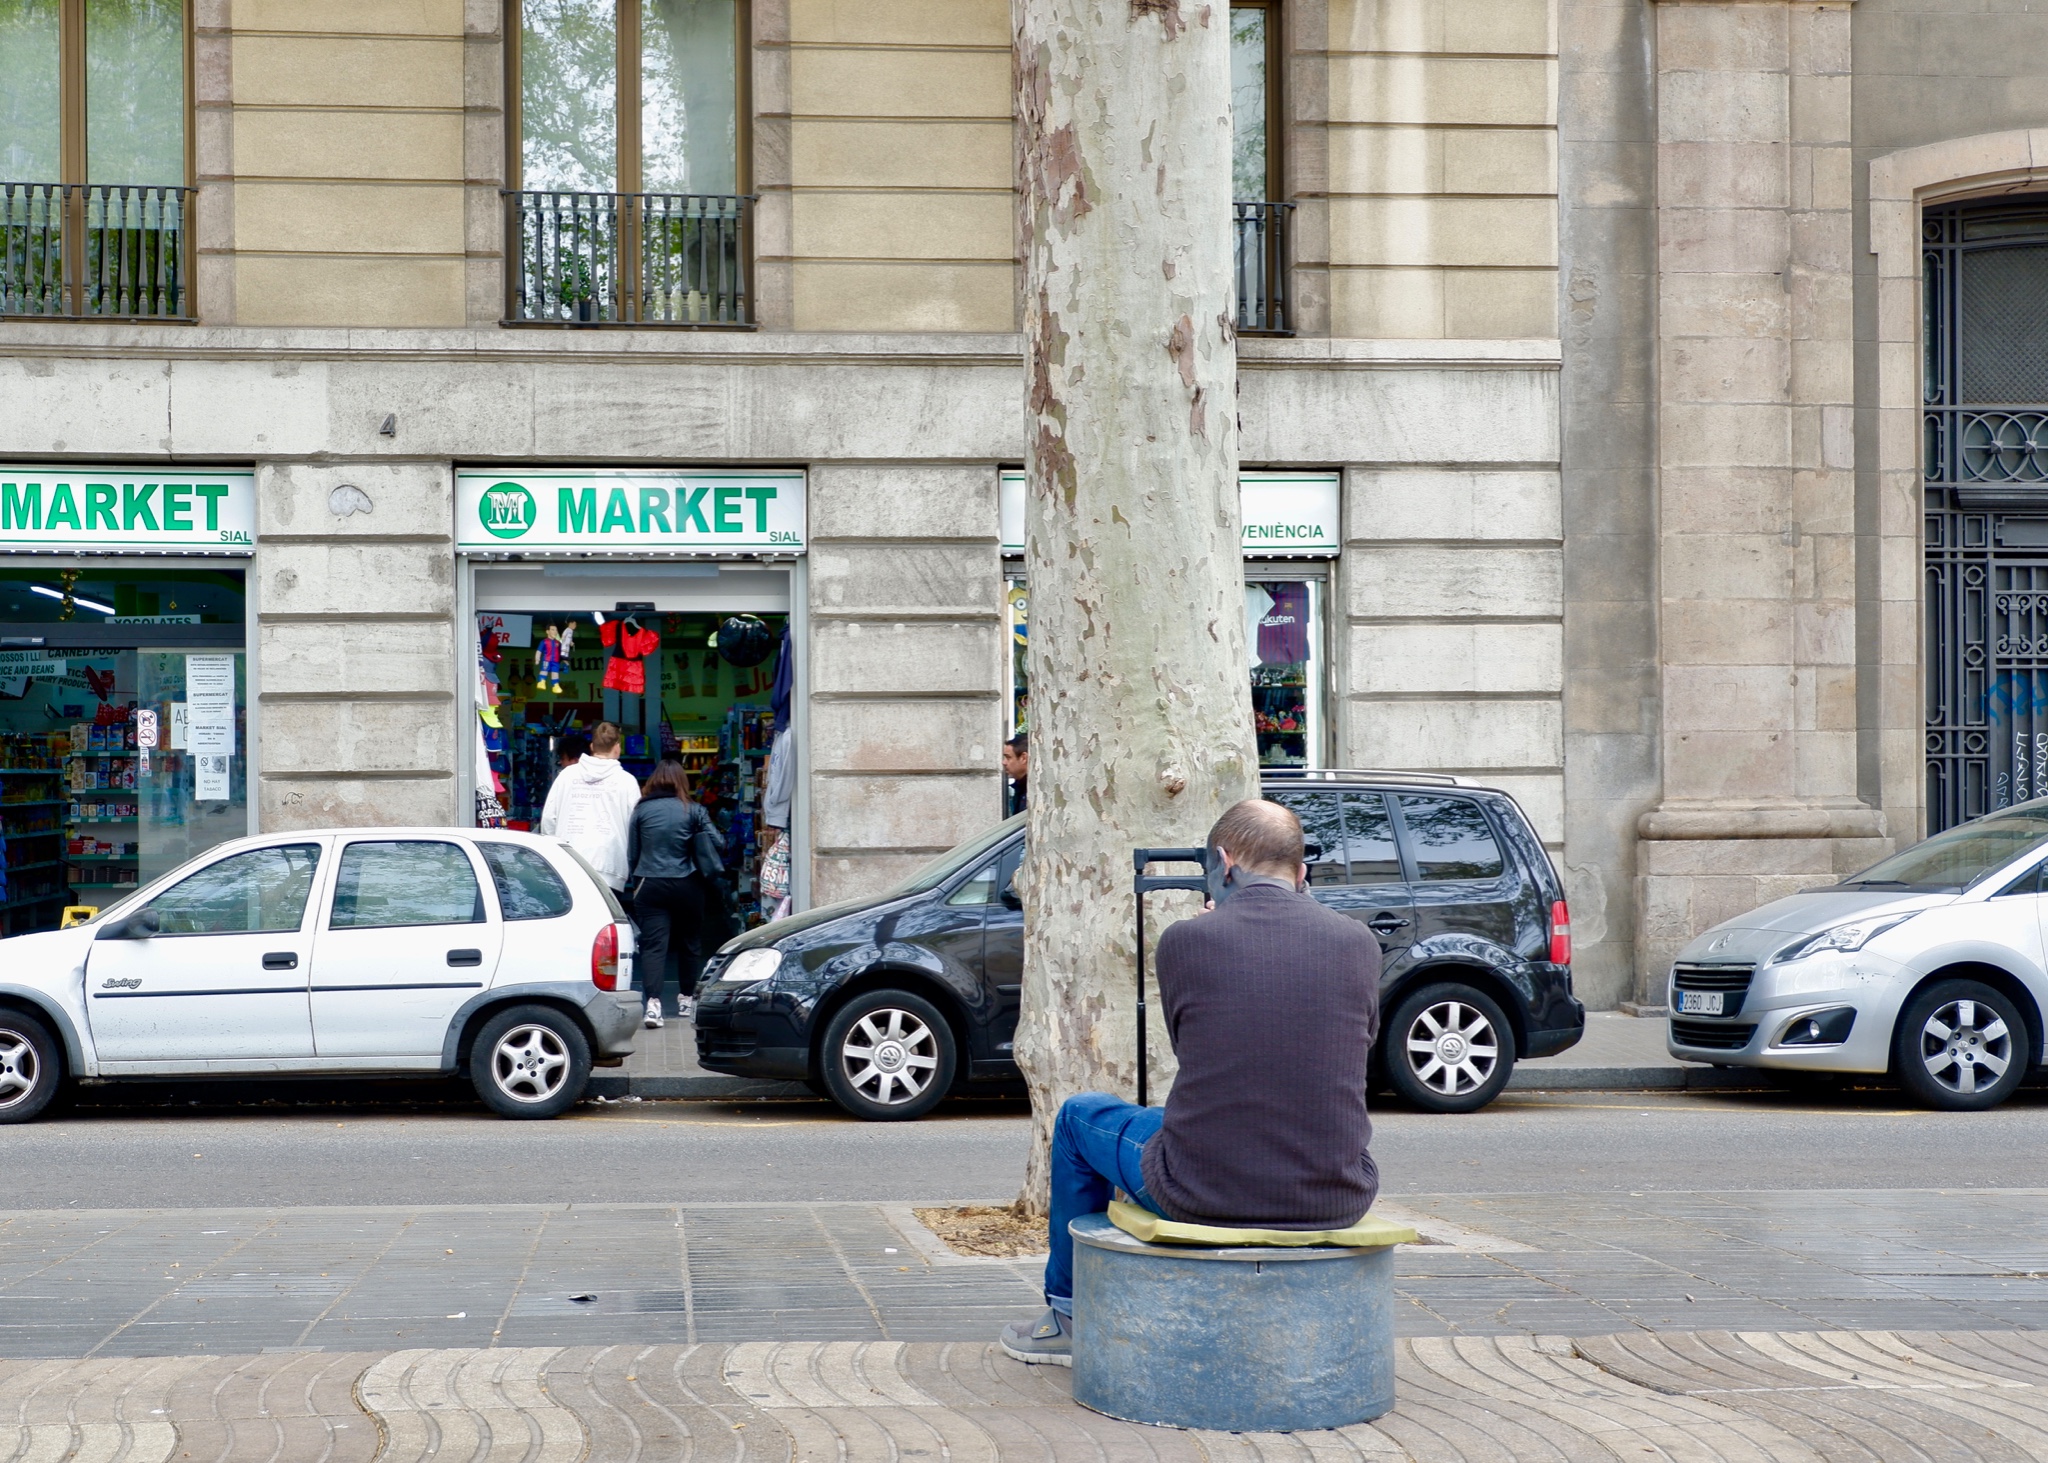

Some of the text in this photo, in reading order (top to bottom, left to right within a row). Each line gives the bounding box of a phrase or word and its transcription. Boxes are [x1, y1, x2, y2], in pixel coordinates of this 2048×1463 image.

[2, 483, 229, 531] MARKET
[558, 487, 778, 533] MARKET
[220, 530, 252, 542] SIAL
[769, 532, 800, 542] SIAL
[0, 652, 24, 662] OSSOS
[48, 648, 90, 658] CANNED
[14, 665, 29, 675] AND
[31, 664, 55, 674] BEANS
[101, 977, 143, 990] Swing
[1683, 994, 1702, 1010] 2360
